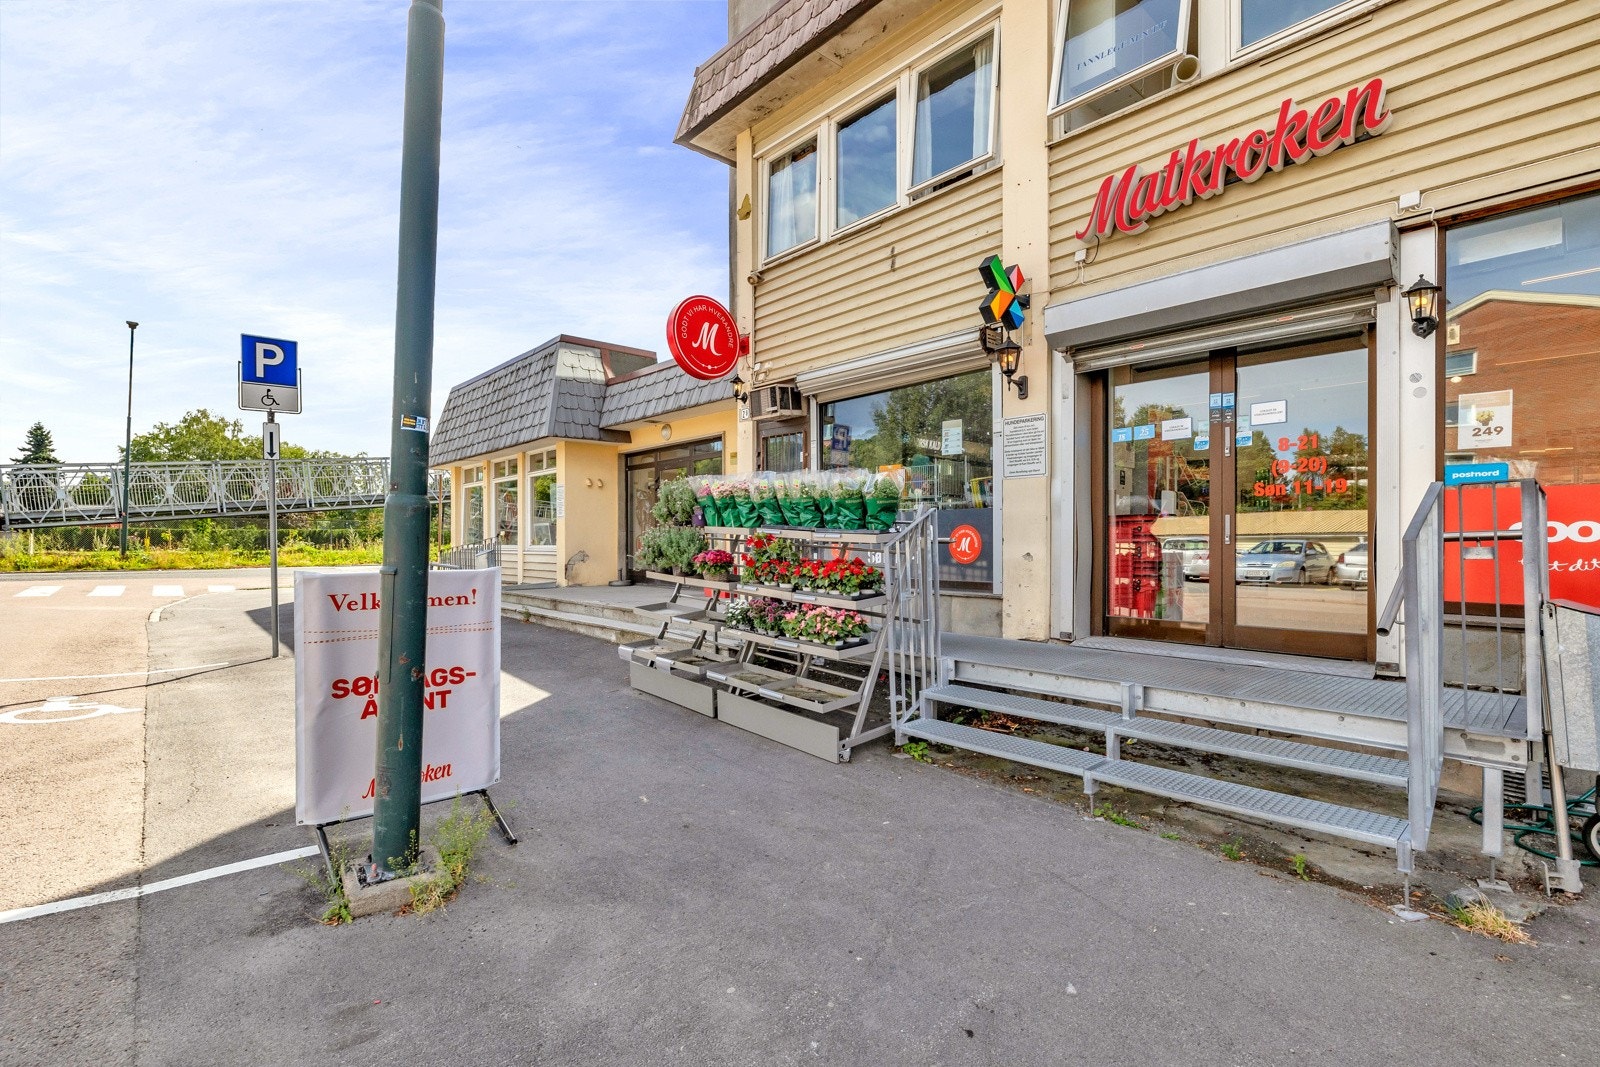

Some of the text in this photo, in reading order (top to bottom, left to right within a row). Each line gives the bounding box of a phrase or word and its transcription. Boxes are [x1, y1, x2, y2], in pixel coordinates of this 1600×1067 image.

[1075, 78, 1391, 241] Matkroken
[681, 304, 734, 349] GODT VI HAR HVERANDRE
[691, 321, 722, 356] M
[255, 342, 285, 378] P
[1004, 416, 1044, 426] HUNDEPARKERING
[1472, 426, 1504, 437] 249
[1278, 434, 1318, 451] 8-21
[1271, 456, 1328, 478] (9-20)
[1452, 470, 1500, 479] postnord
[1253, 477, 1347, 497] Søn 11-19
[956, 536, 971, 553] M
[327, 588, 477, 612] Velkmen!
[331, 666, 477, 699] SØGS-
[360, 689, 452, 720] ÅNT
